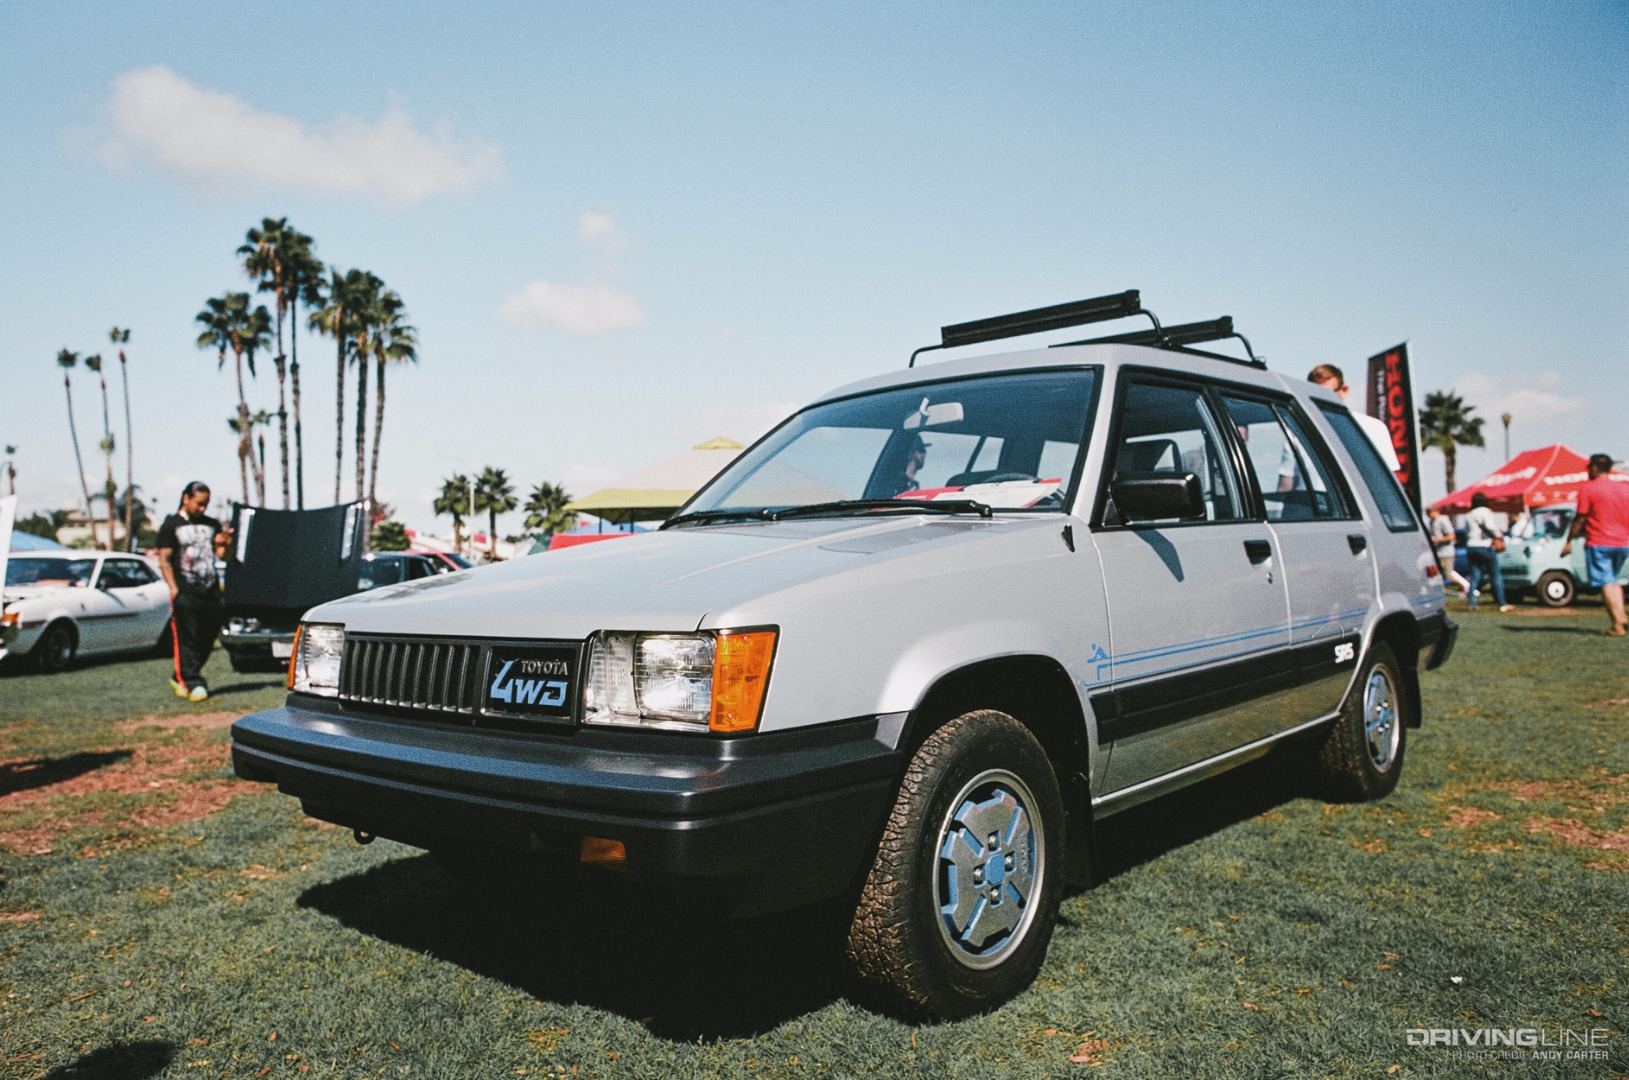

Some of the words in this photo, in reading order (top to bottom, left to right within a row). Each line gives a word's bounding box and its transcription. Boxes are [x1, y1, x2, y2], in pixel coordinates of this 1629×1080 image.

[1385, 352, 1412, 486] HOND
[490, 660, 569, 707] 4WD
[521, 660, 569, 675] TOYOTA
